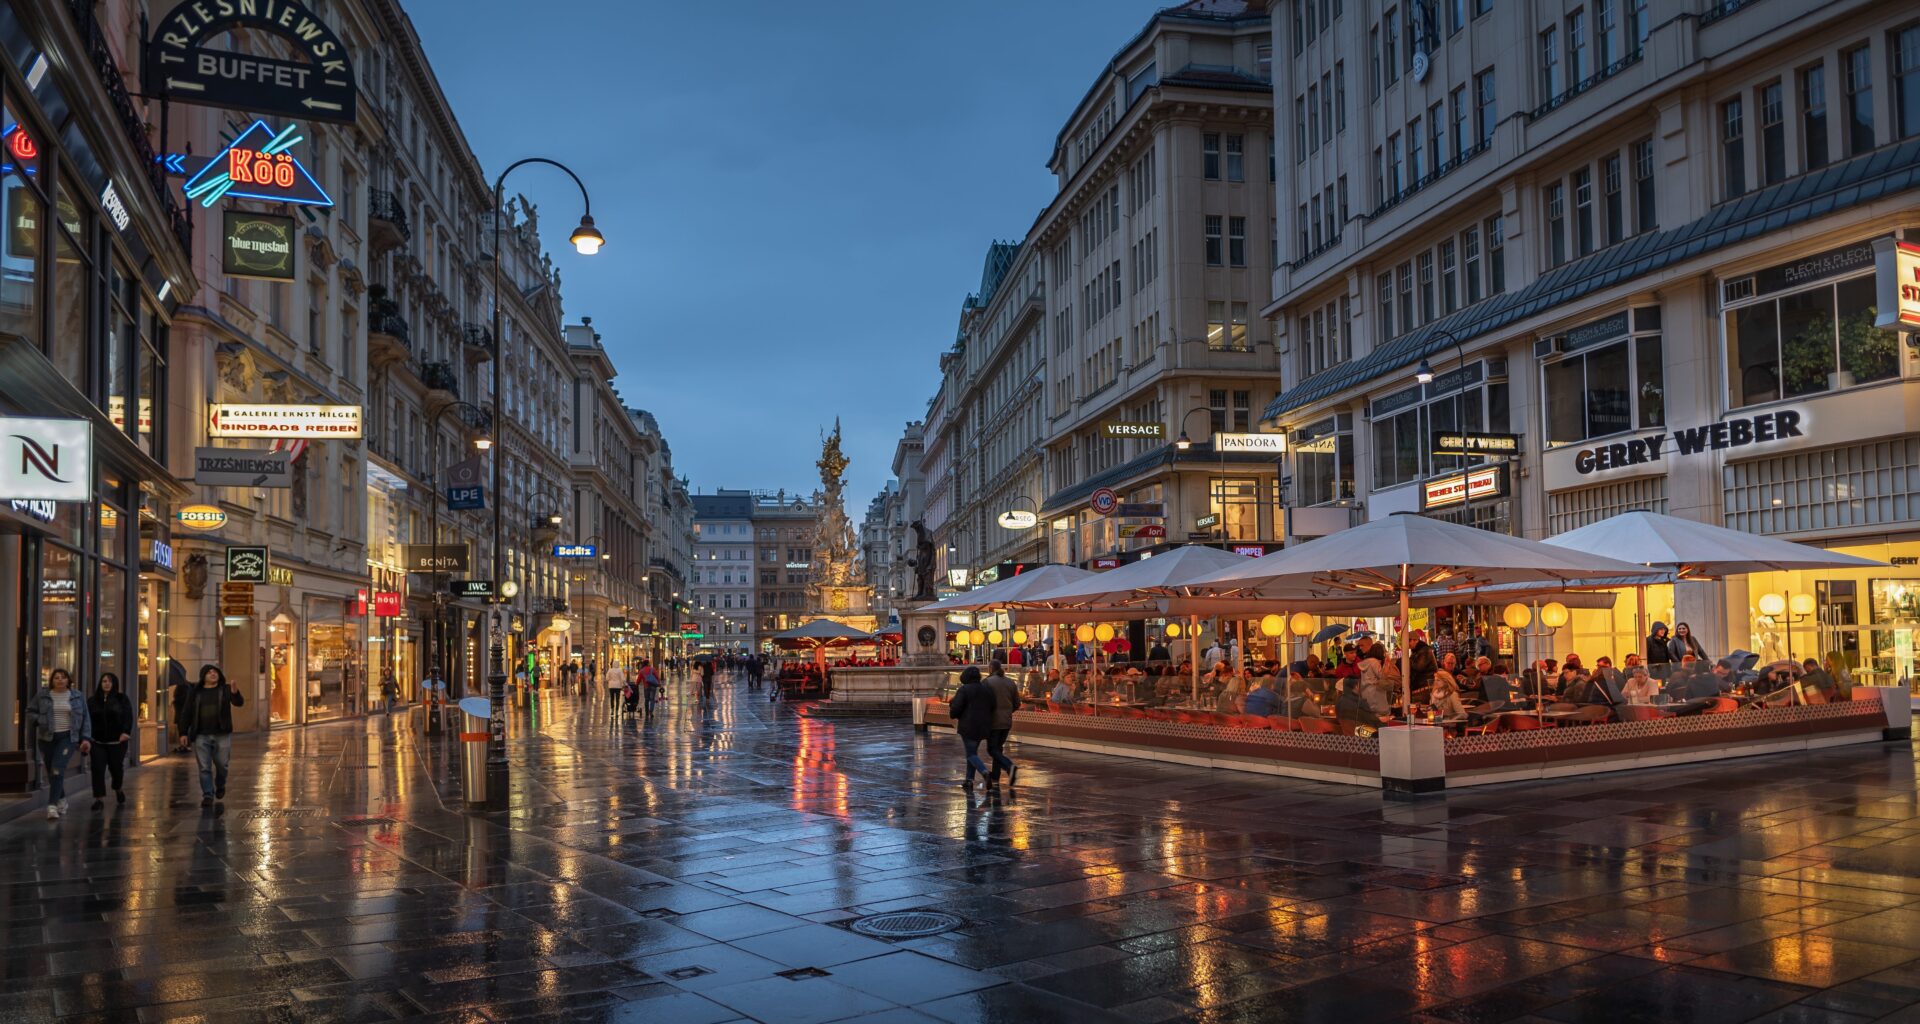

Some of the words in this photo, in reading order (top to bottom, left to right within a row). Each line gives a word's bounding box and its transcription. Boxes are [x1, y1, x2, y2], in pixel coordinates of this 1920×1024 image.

[198, 53, 311, 89] BUFFET
[229, 148, 294, 187] Köö
[228, 236, 250, 249] blue
[1785, 262, 1822, 278] PLECH
[1834, 246, 1872, 264] PLECH
[1902, 284, 1920, 302] ST
[1108, 425, 1160, 435] VERSACE
[1224, 437, 1277, 447] PANDORA
[1477, 437, 1515, 449] WEBER
[1575, 434, 1665, 475] GERRY
[1674, 410, 1803, 456] WEBER
[198, 457, 285, 474] TRZEŚNIEWSKI
[452, 489, 478, 501] LPE
[1428, 487, 1452, 499] WIENER
[181, 512, 223, 520] FOSSIL
[1197, 516, 1215, 527] VERSACE
[559, 546, 591, 555] Berlitz
[1235, 547, 1263, 557] CAMPER
[1890, 556, 1919, 565] GERRY
[468, 583, 487, 591] IWC
